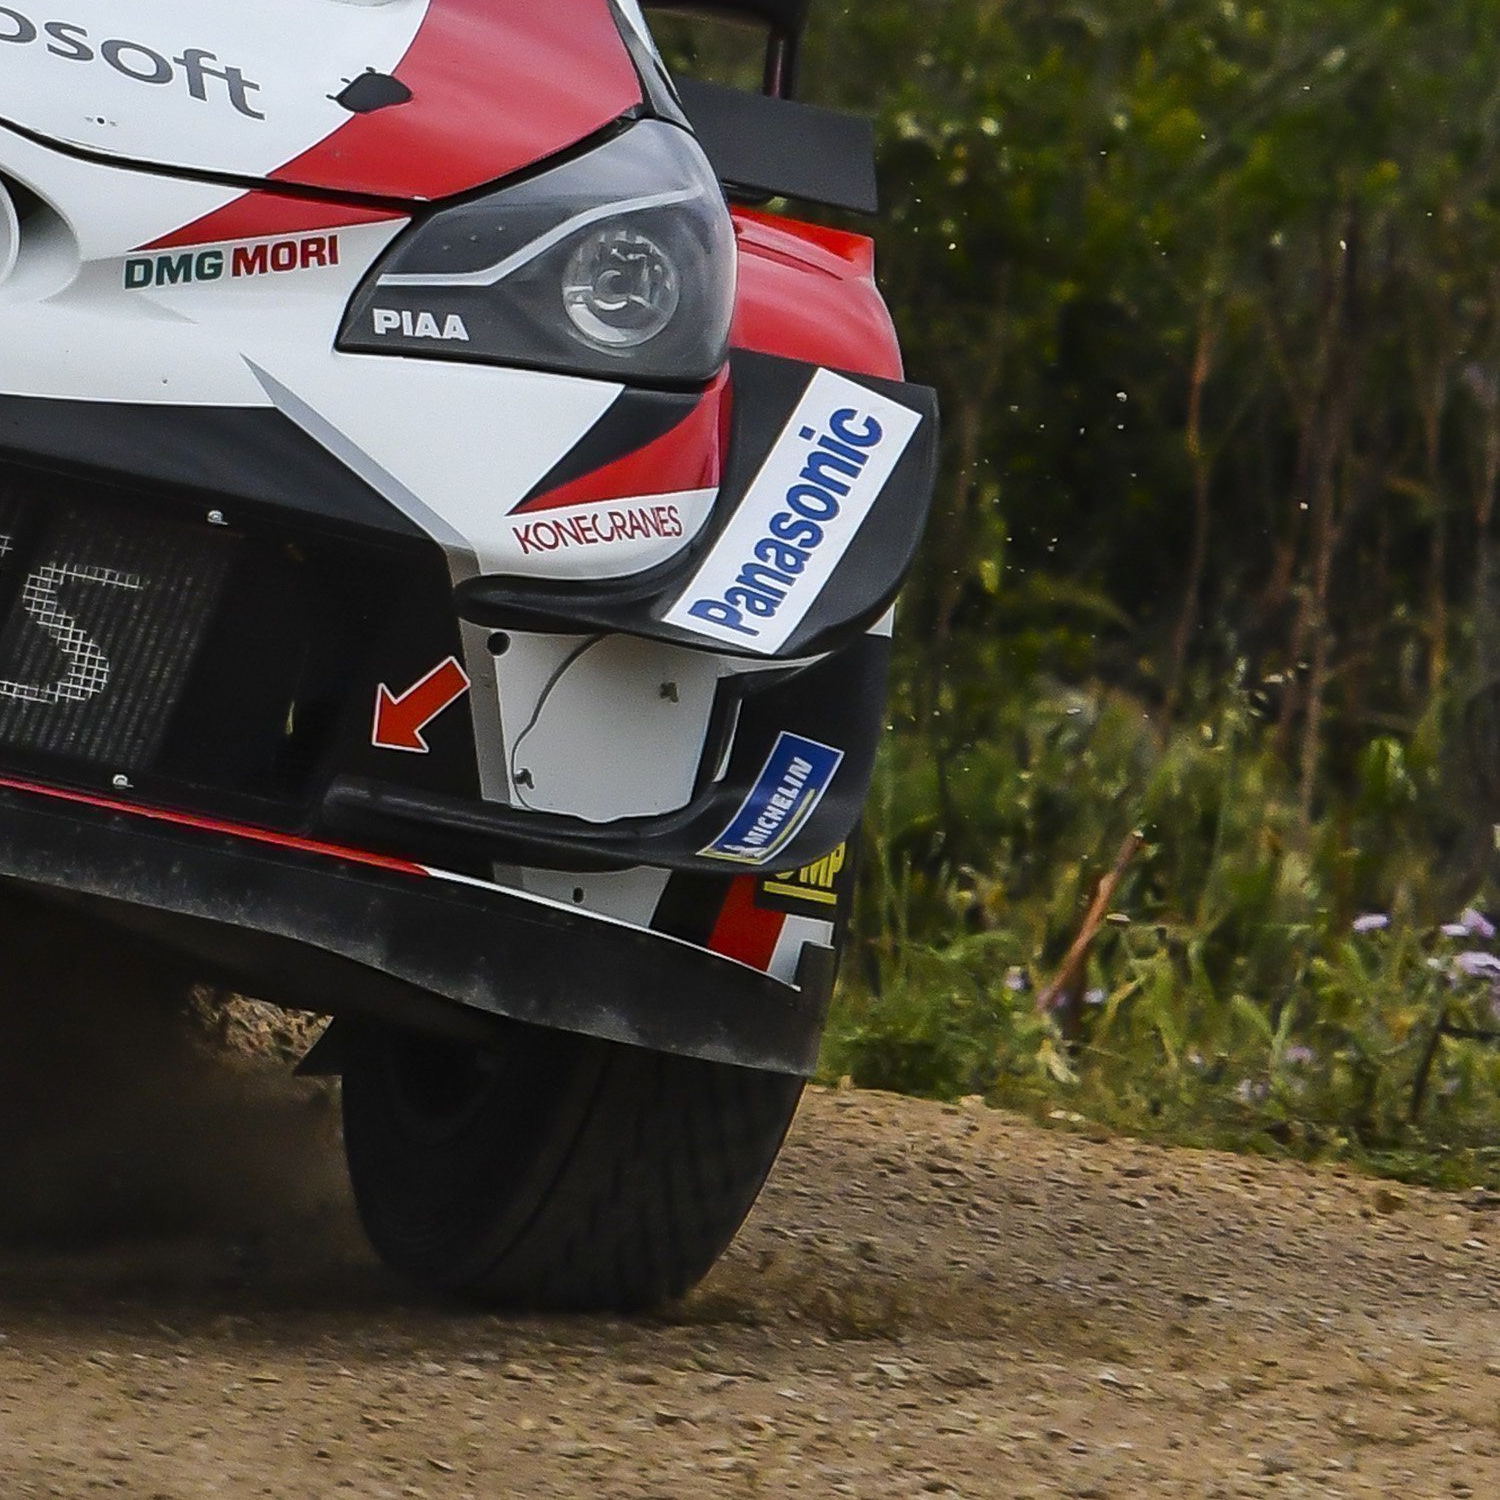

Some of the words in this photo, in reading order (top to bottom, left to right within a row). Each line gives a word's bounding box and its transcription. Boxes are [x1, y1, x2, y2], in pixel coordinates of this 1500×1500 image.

[124, 250, 224, 290] DMG
[229, 235, 340, 278] MORI
[372, 308, 471, 343] PIAA
[511, 505, 684, 555] KONECRANES
[686, 405, 885, 638] Panasonic
[741, 755, 814, 846] MICHELIN
